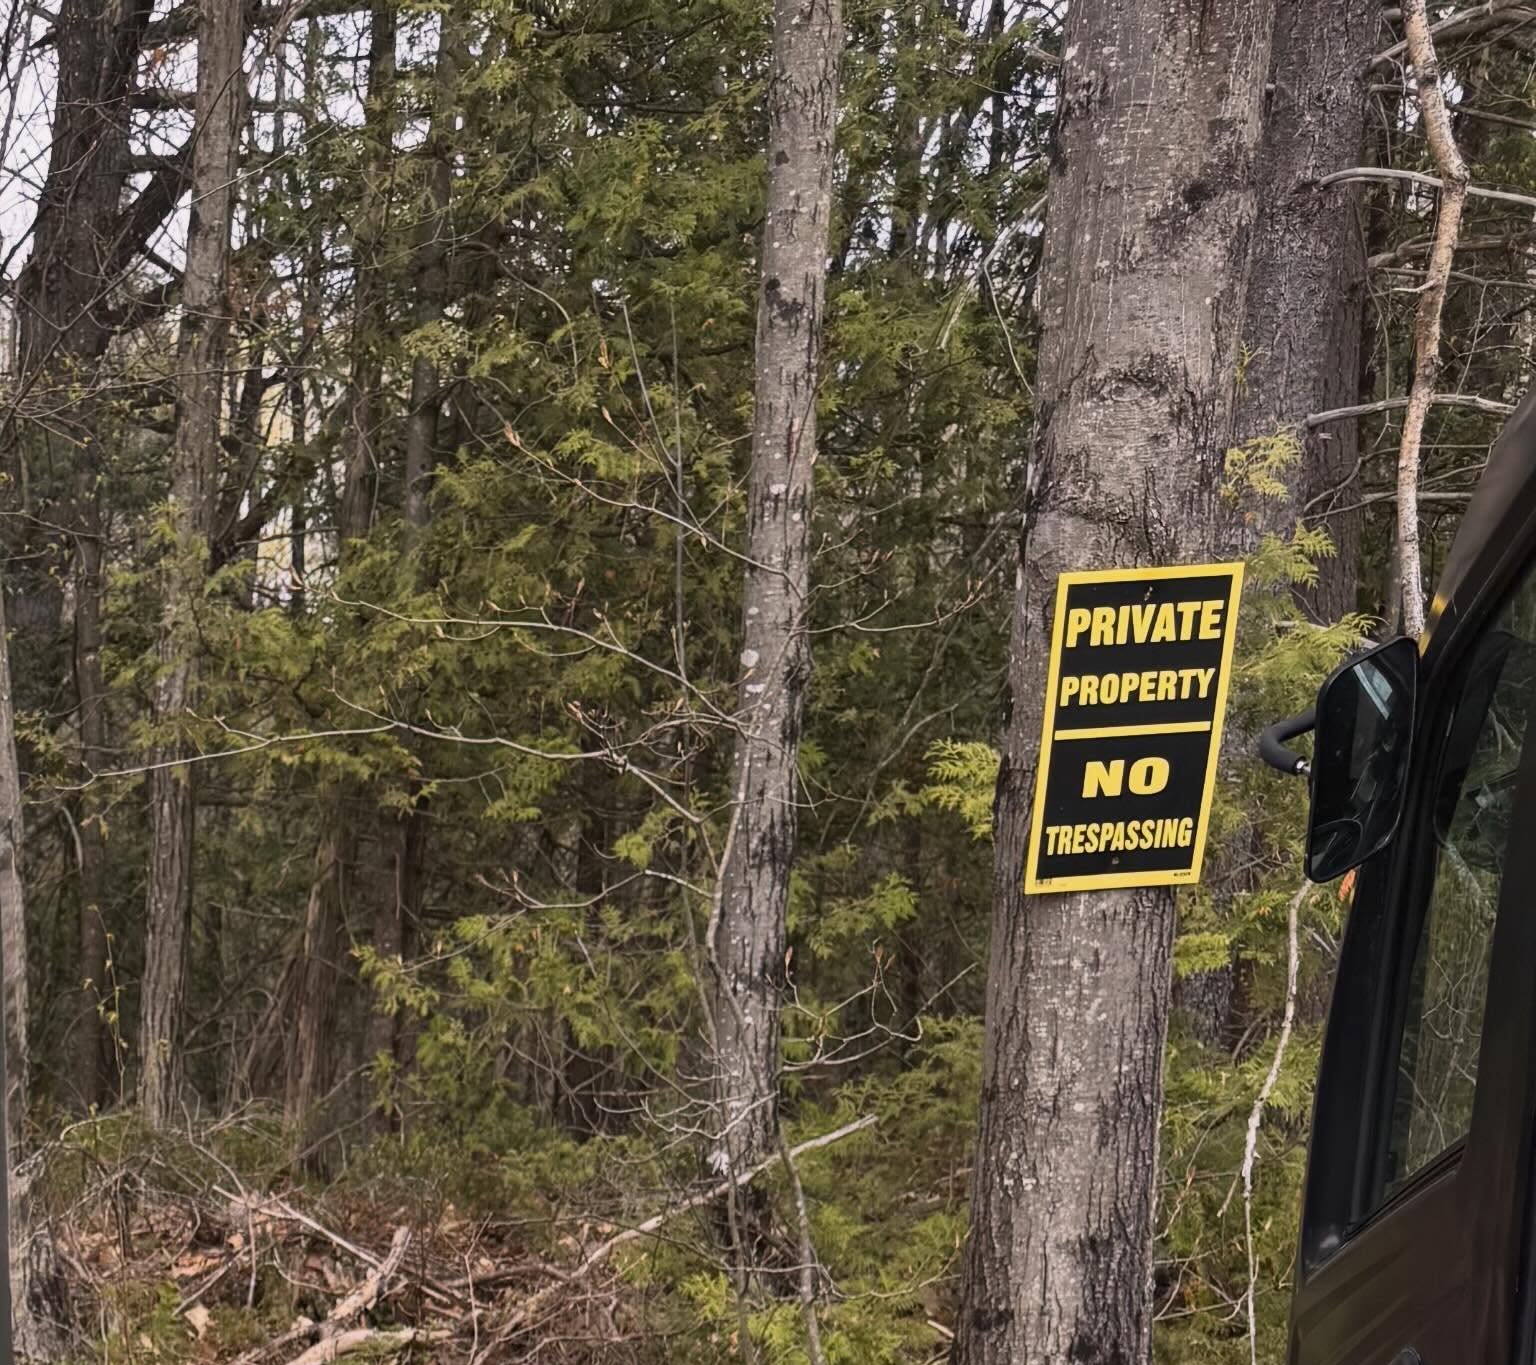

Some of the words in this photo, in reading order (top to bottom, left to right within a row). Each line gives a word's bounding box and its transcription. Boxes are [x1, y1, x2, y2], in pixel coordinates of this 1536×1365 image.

[1065, 599, 1225, 648] PRIVATE
[1059, 668, 1215, 707] PROPERTY
[1081, 757, 1170, 799] NO
[1045, 817, 1194, 856] TRESPASSING
